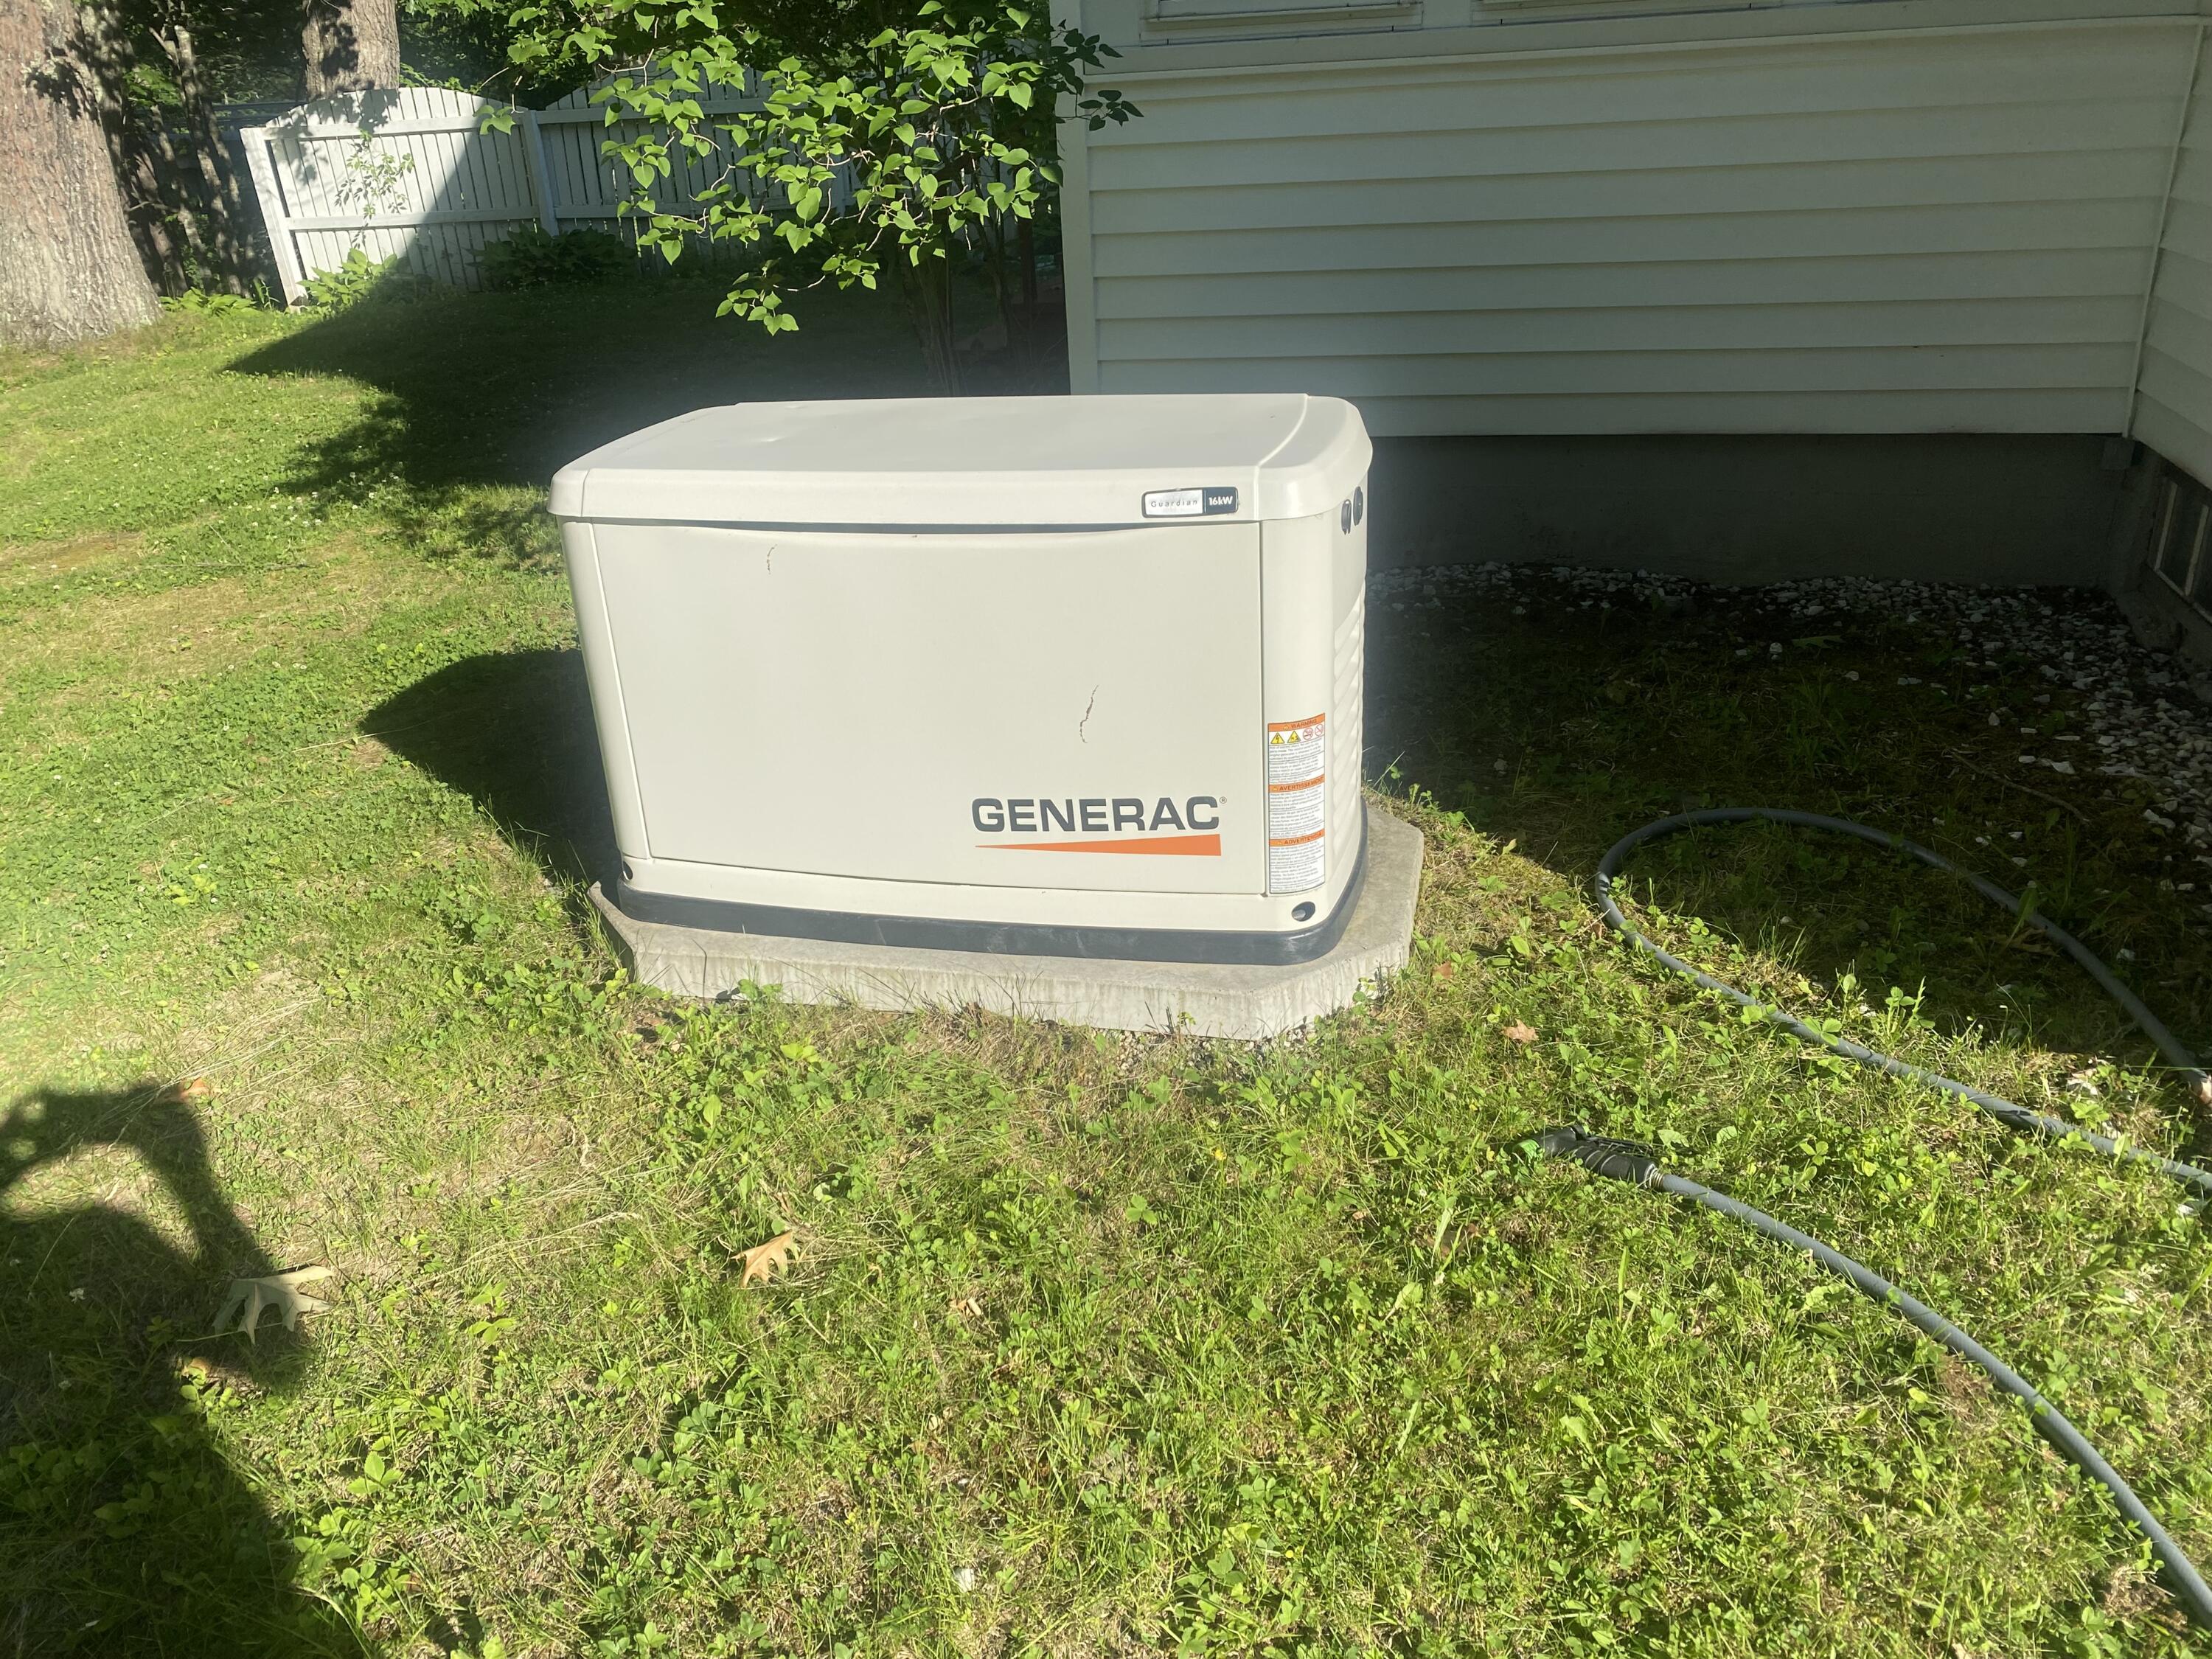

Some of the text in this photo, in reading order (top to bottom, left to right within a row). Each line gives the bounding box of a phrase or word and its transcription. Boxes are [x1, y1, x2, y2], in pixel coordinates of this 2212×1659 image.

[1208, 495, 1233, 506] 16kW
[1291, 719, 1317, 728] WARNING
[972, 796, 1220, 832] GENERAC
